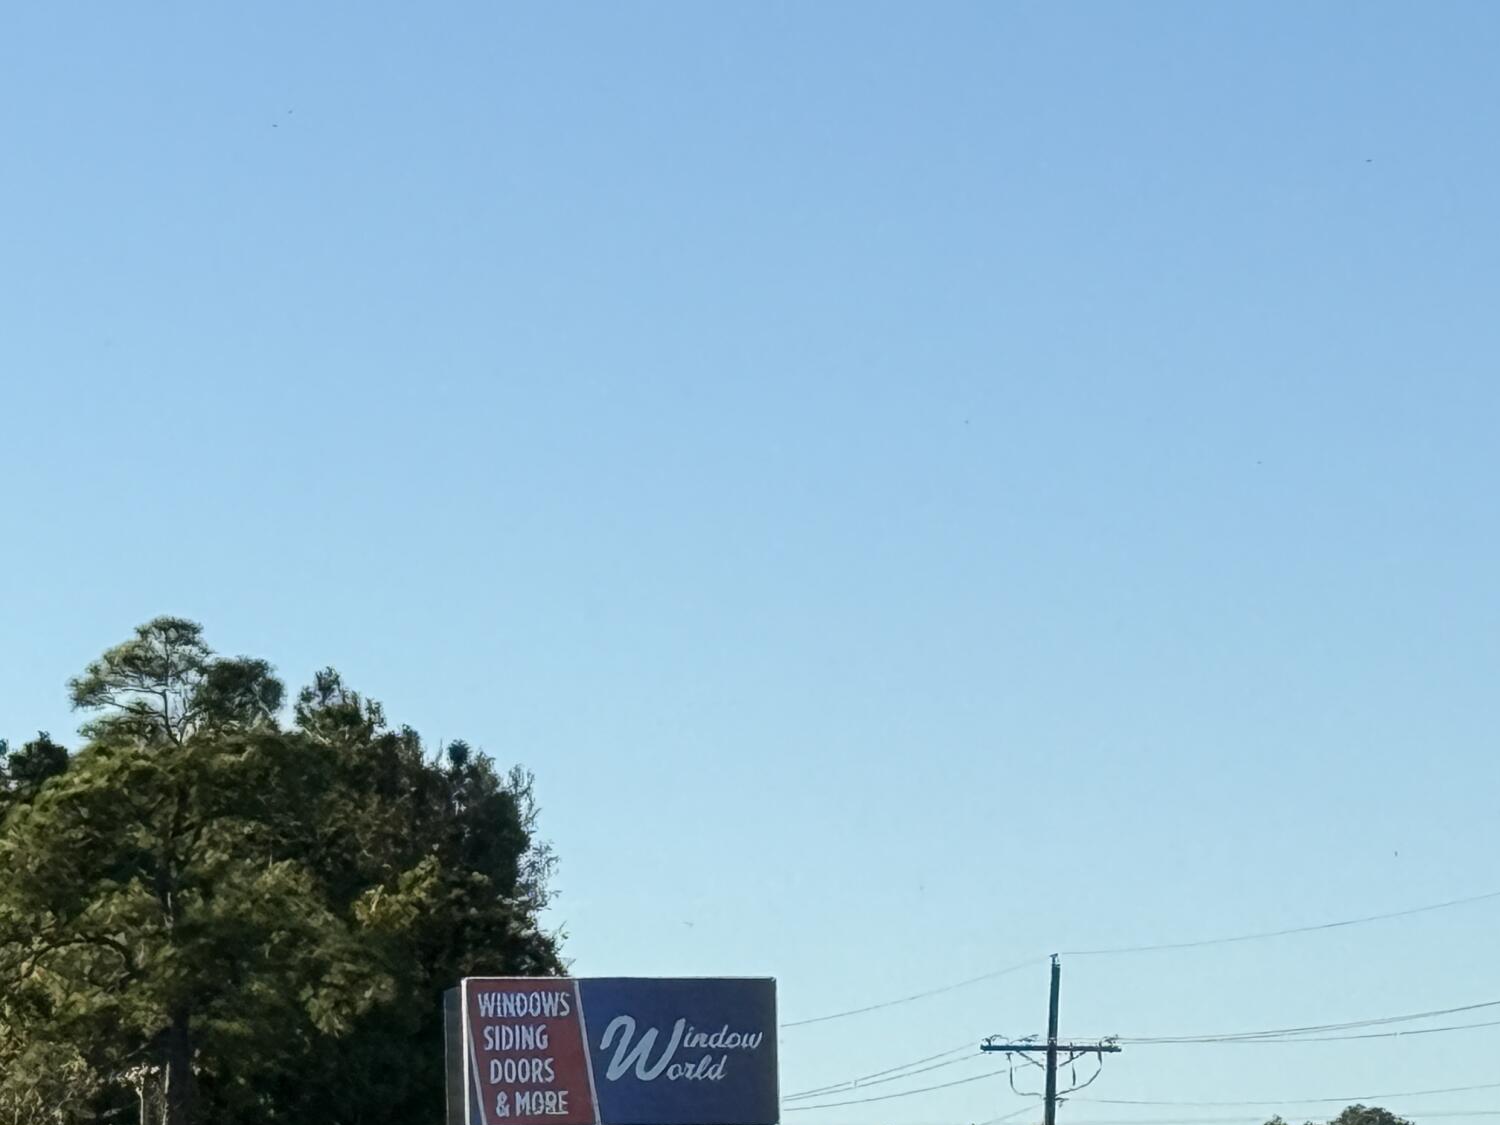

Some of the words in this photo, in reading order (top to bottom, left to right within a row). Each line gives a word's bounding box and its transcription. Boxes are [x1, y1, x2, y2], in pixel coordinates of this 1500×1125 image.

[478, 992, 570, 1017] WINDOWS
[483, 1025, 549, 1050] SIDING
[600, 1015, 764, 1081] Window
[490, 1058, 554, 1084] DOORS
[496, 1091, 510, 1117] &
[515, 1090, 569, 1115] MORE
